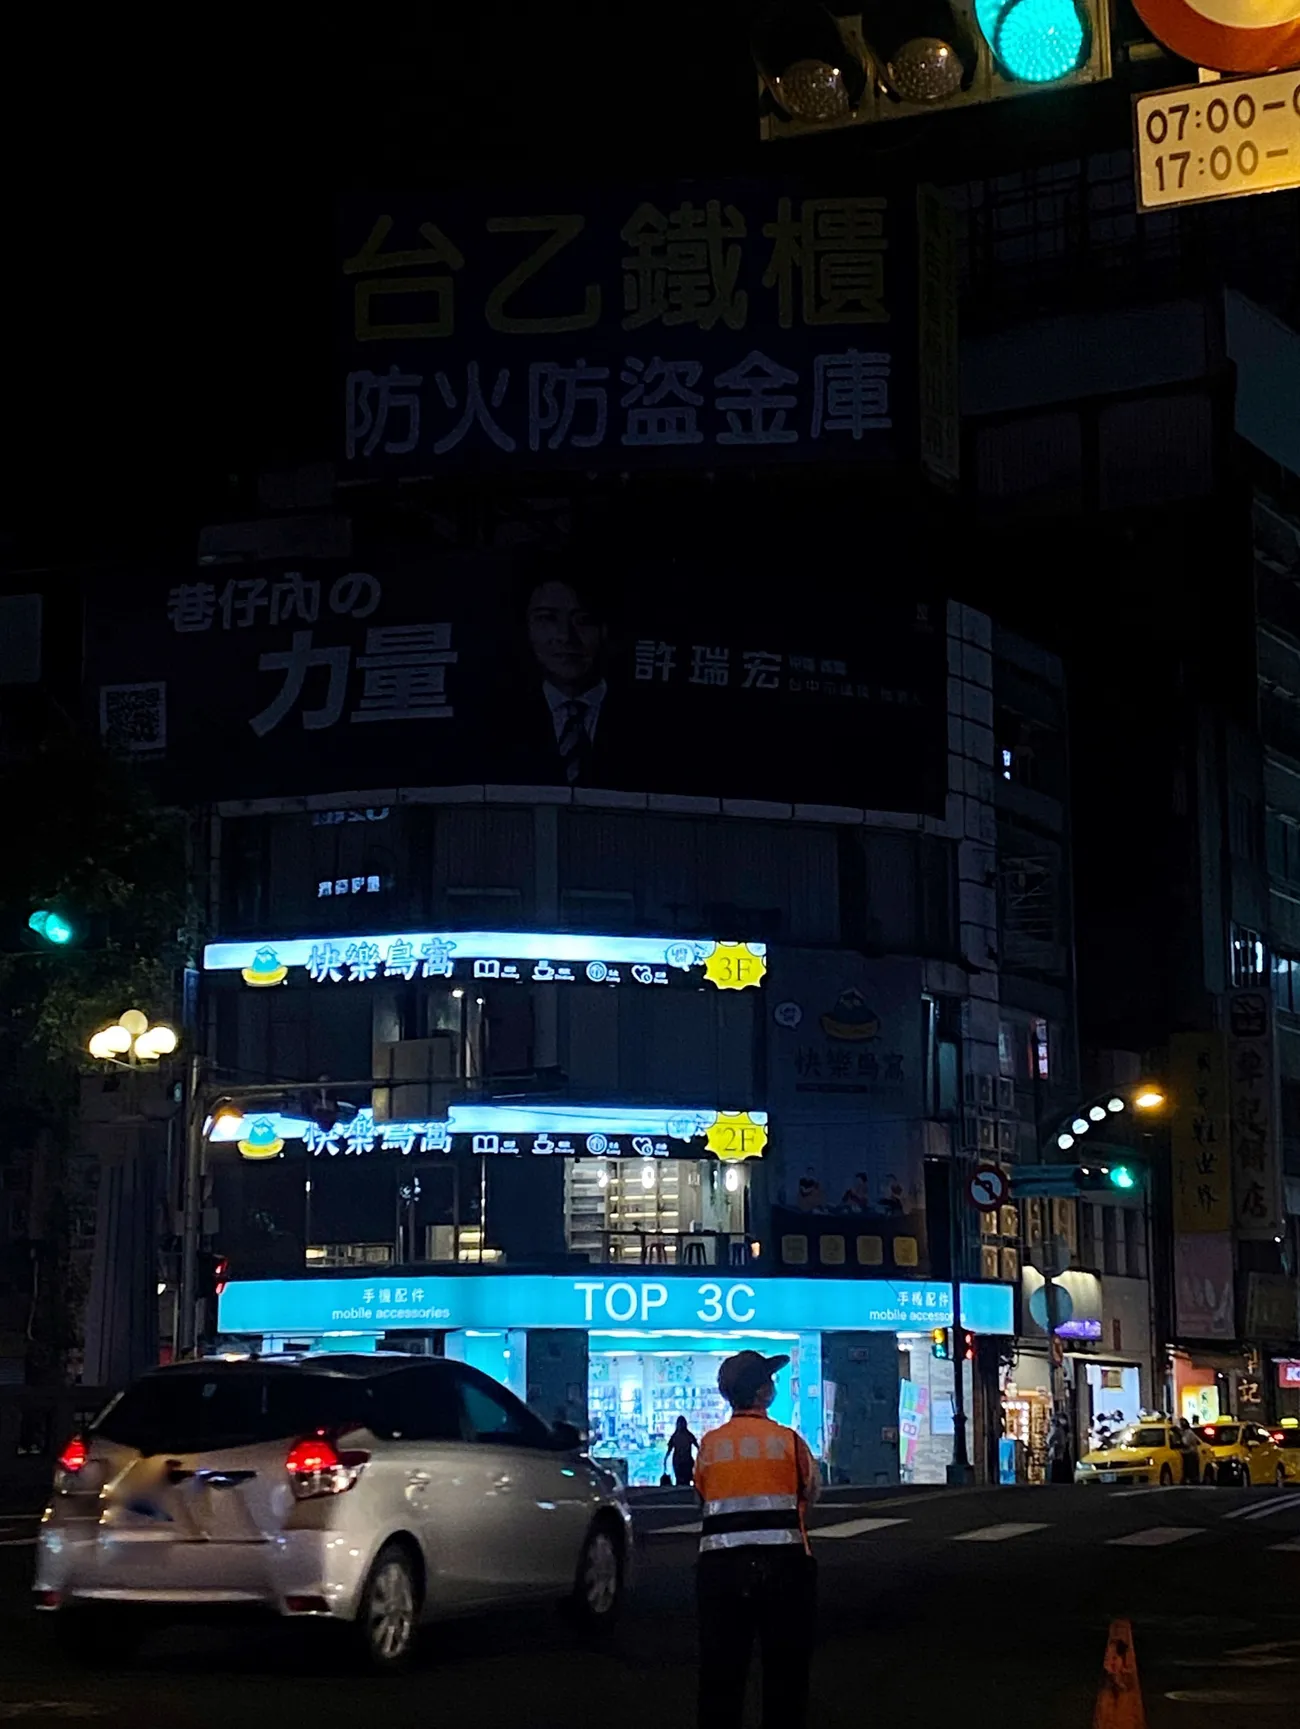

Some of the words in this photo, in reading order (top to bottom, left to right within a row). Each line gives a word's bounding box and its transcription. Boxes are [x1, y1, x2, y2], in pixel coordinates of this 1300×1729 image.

[342, 195, 890, 342] 台乙鐵櫃
[344, 346, 893, 460] 防火防盜金庫
[166, 571, 383, 633] 巷仔內の
[248, 622, 459, 738] 力量
[305, 938, 457, 982] 快樂鳥窩
[719, 956, 752, 982] 3F
[723, 1127, 756, 1152] 2F
[331, 1306, 372, 1320] mobile
[376, 1306, 450, 1319] accessories
[362, 1287, 425, 1303] 手機配件
[574, 1283, 667, 1321] TOP
[697, 1283, 755, 1322] 3C
[869, 1307, 907, 1321] mobile
[909, 1310, 966, 1322] accessos
